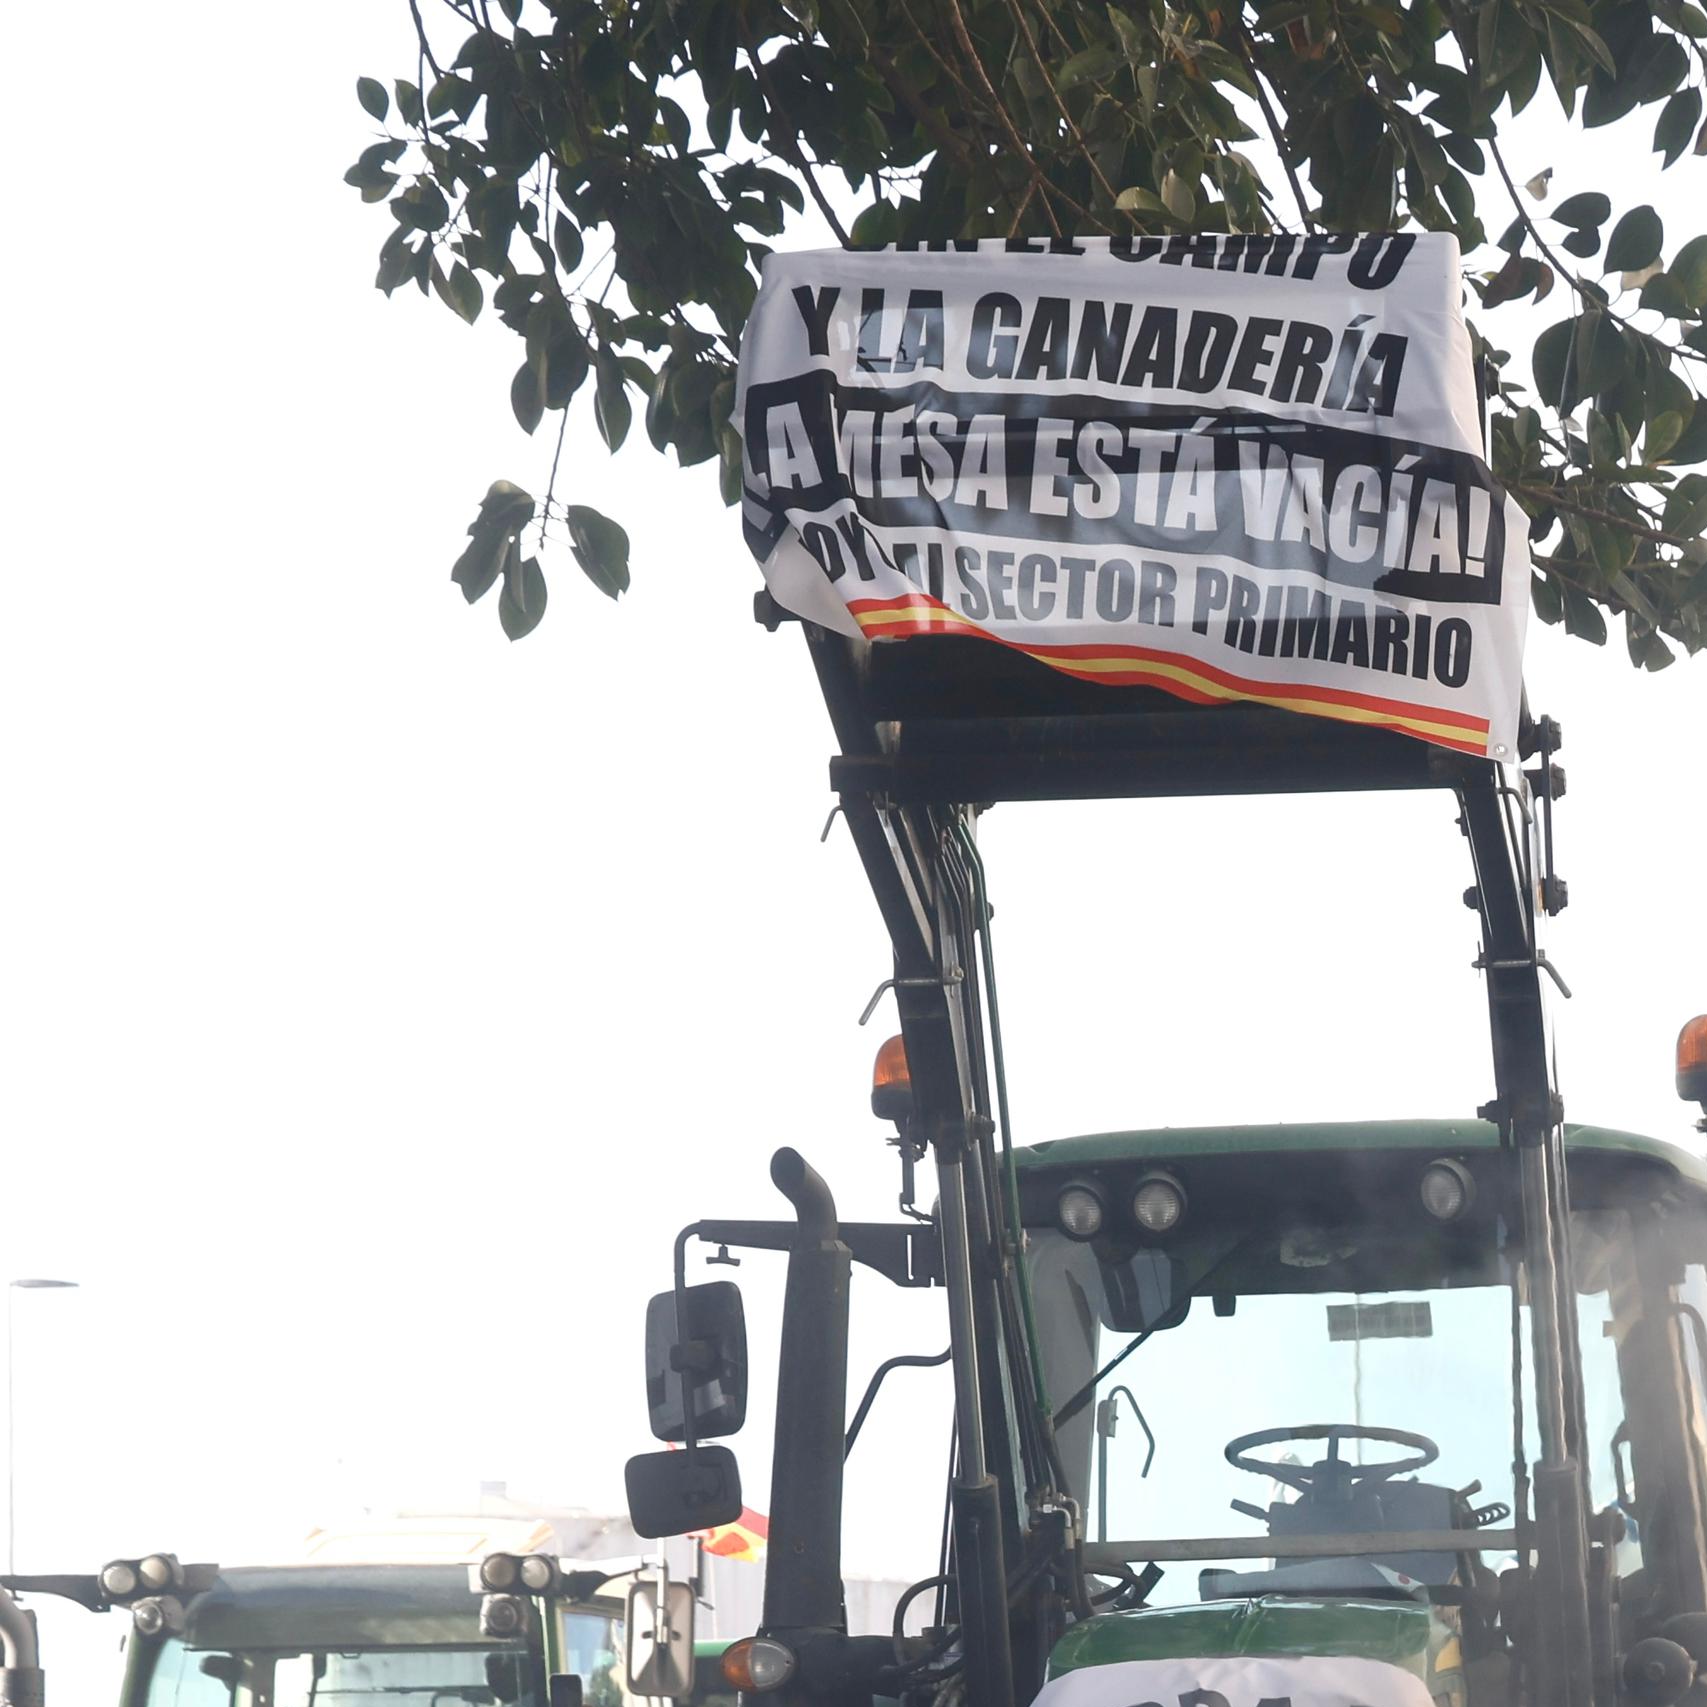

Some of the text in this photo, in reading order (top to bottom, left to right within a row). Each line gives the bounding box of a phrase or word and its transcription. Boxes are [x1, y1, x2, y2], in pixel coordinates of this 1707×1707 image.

[793, 286, 1408, 418] Y LA GANADERÍA
[830, 393, 1009, 511] MESA
[1029, 415, 1217, 533] ESTÁ
[1238, 441, 1488, 580] VACÍA!
[955, 546, 1174, 628] SECTOR
[1192, 572, 1472, 688] PRIMARIO
